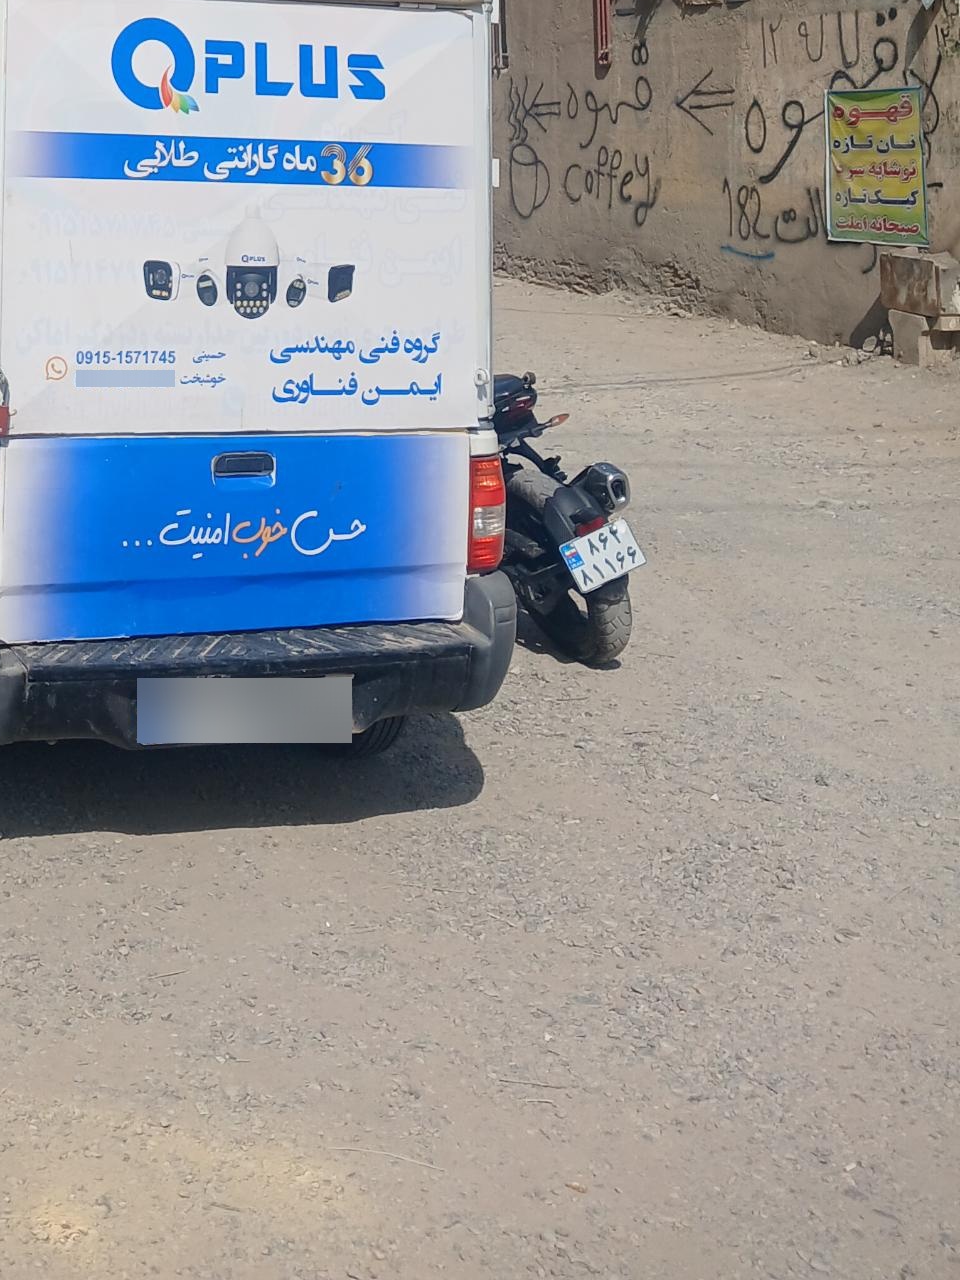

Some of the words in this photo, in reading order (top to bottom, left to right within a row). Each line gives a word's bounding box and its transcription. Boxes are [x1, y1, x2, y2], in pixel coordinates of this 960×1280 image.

[832, 94, 913, 126] قهوه
[123, 140, 200, 178] طلایی
[283, 144, 317, 173] ماه
[833, 135, 873, 153] تازه
[876, 134, 916, 153] نان
[203, 144, 278, 180] گارانتی
[321, 144, 375, 186] 36
[869, 160, 918, 182] نوشابه
[835, 188, 867, 207] تازه
[868, 188, 919, 210] کیک
[870, 217, 920, 238] صبحانه
[76, 350, 176, 366] 0915-1571745
[192, 351, 226, 365] حسینی
[270, 335, 355, 366] مهندسی
[359, 330, 400, 365] فنی
[404, 330, 440, 361] گروه
[179, 371, 226, 388] خوشبخت
[272, 372, 358, 405] فناوری
[361, 372, 442, 406] ایمن
[159, 509, 231, 559] امنیت
[232, 508, 288, 559] خوب
